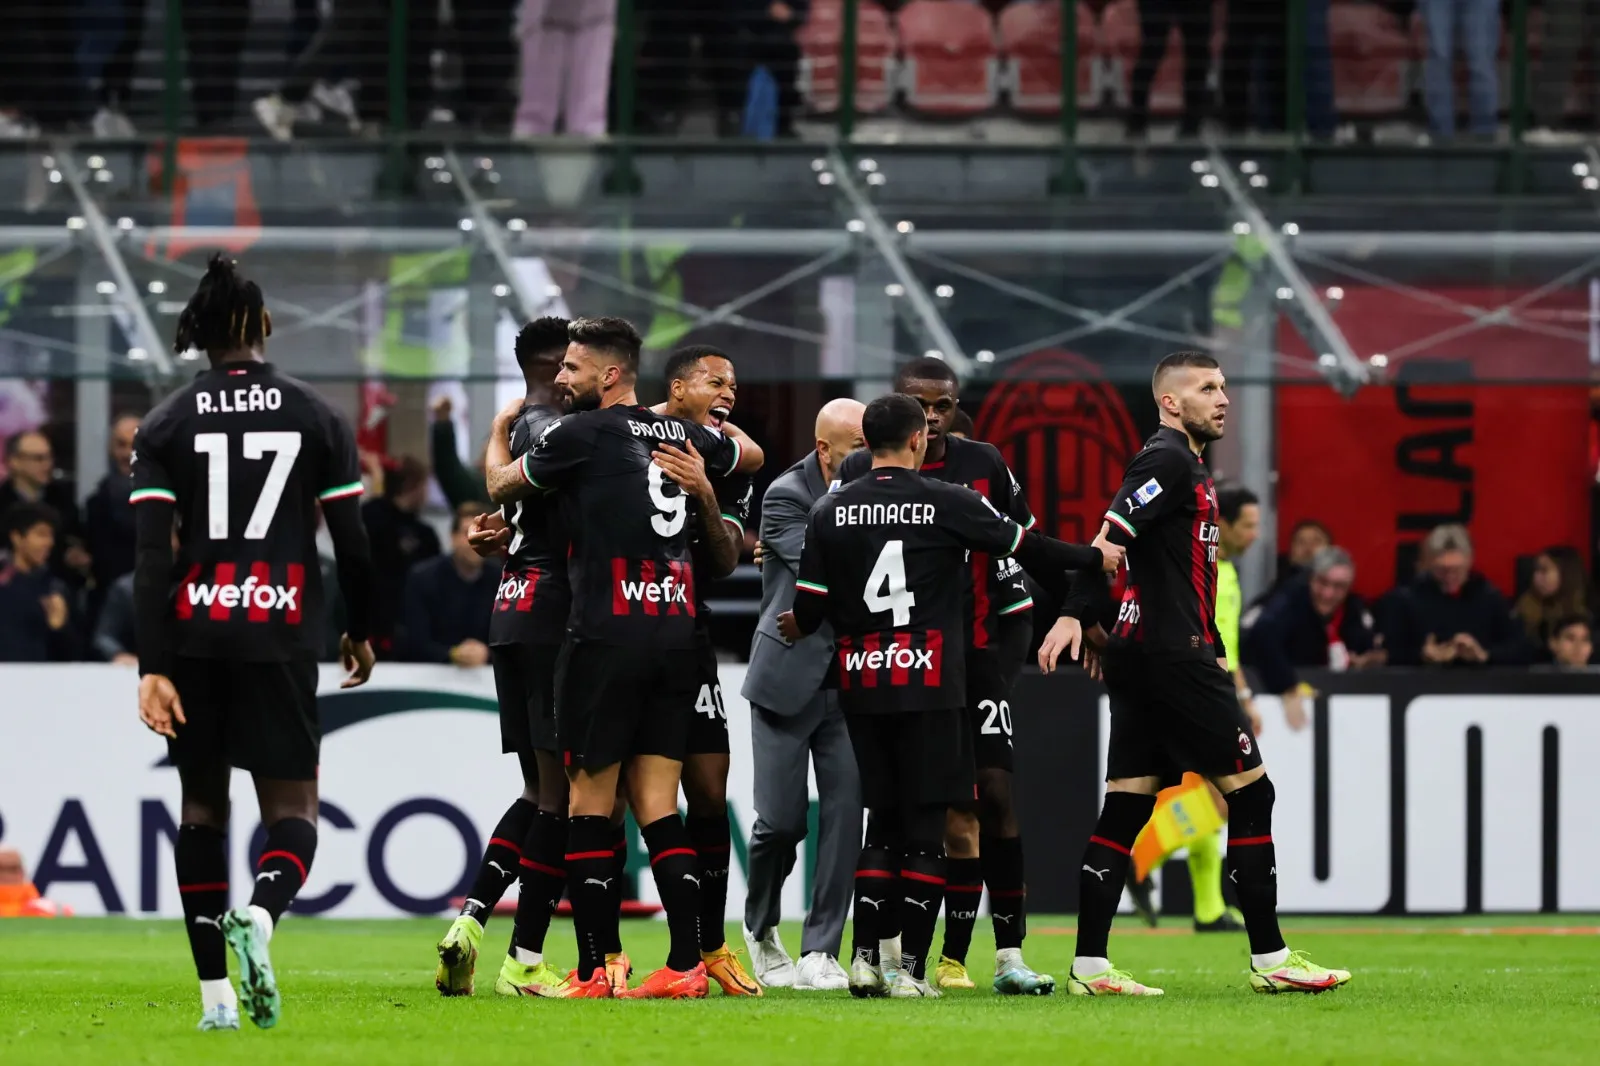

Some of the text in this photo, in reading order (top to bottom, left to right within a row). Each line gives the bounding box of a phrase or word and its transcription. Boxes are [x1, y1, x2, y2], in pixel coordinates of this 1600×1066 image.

[196, 384, 282, 415] R.LEÃO
[194, 432, 302, 540] 17
[647, 457, 690, 538] 9
[835, 503, 936, 527] BENNACER
[187, 576, 298, 611] wefox
[863, 540, 916, 628] 4
[845, 642, 933, 672] wefox
[694, 683, 727, 720] 40
[977, 699, 1013, 737] 20
[0, 798, 483, 915] ANCO
[950, 909, 976, 920] ACM
